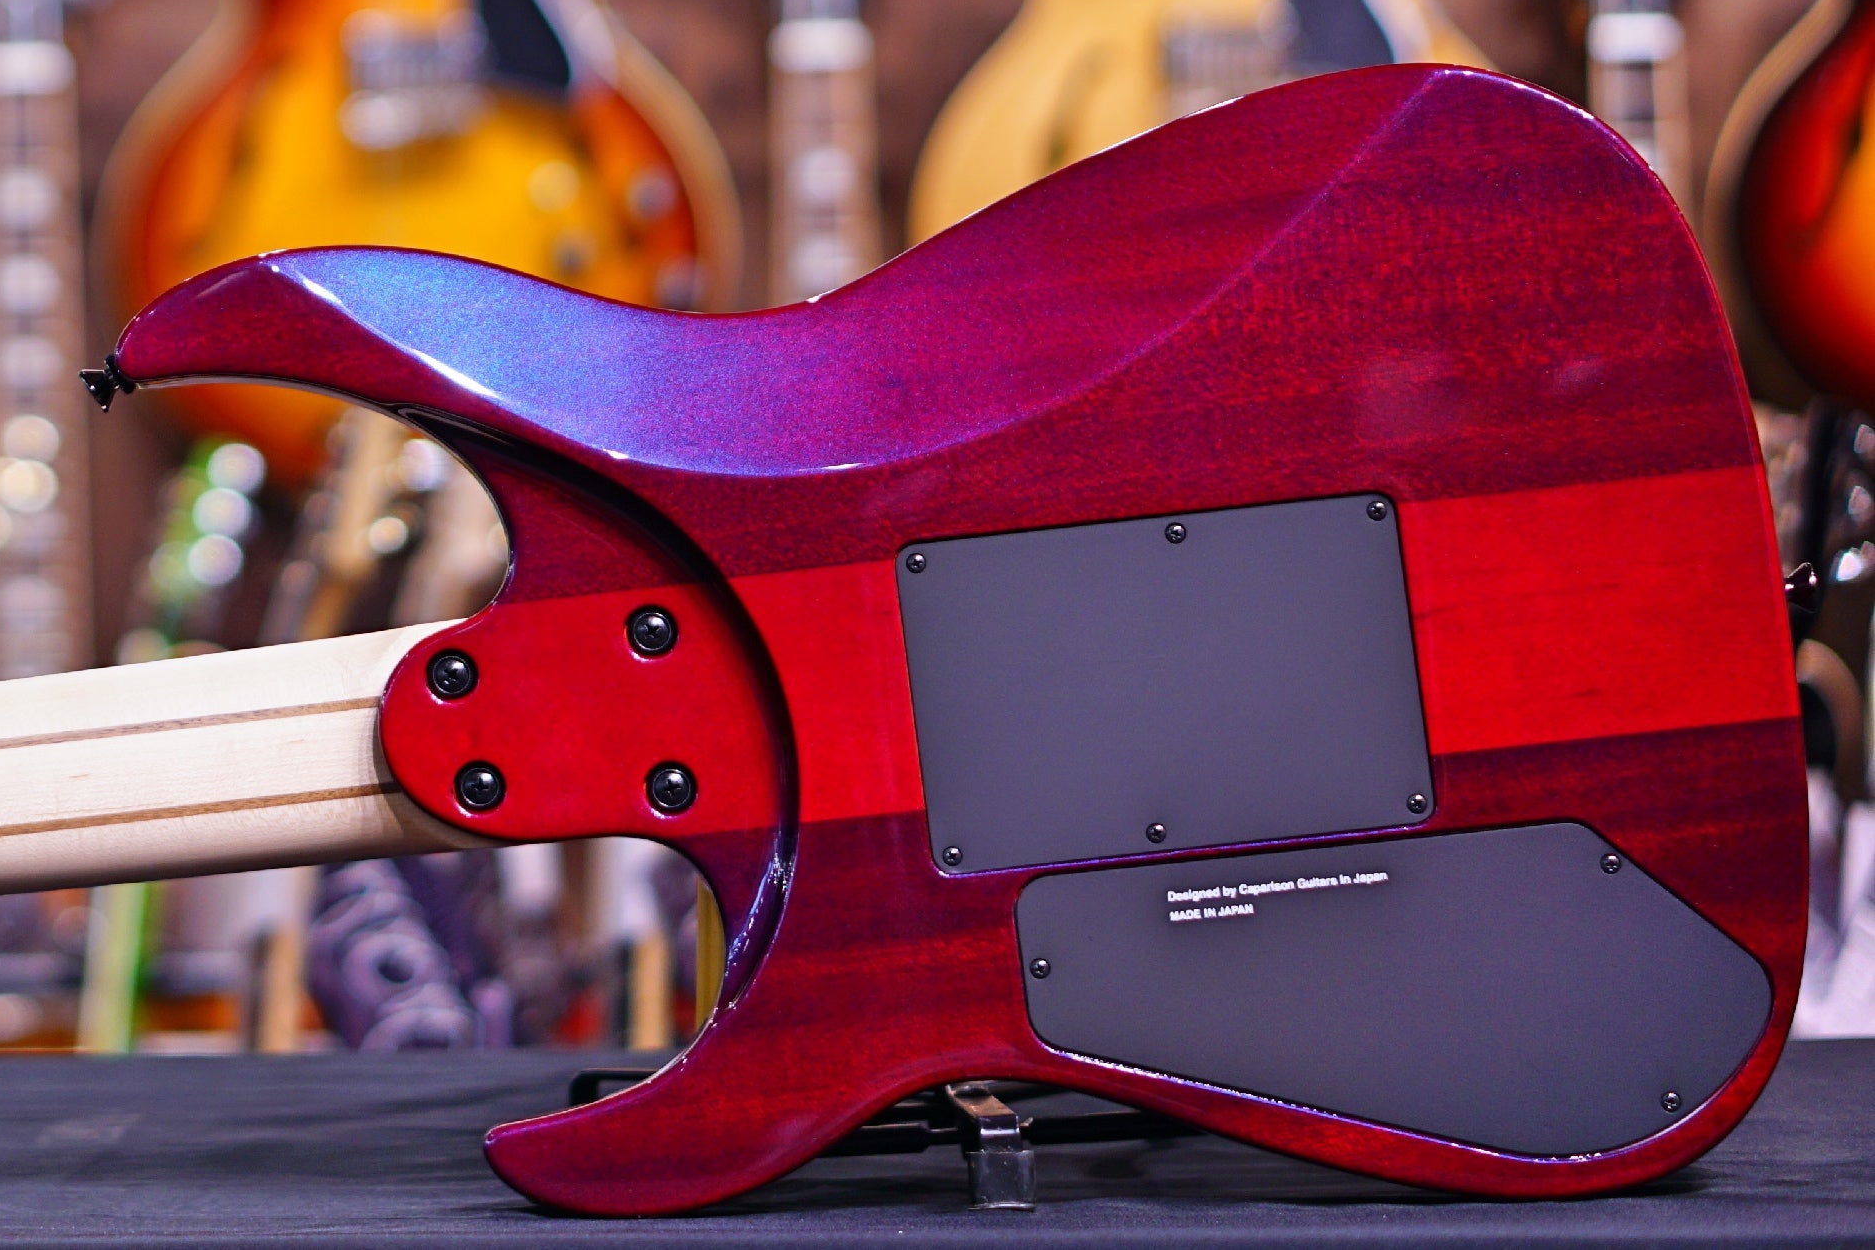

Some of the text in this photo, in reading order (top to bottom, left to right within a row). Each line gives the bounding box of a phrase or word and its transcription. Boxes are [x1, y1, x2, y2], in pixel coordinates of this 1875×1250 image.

[1167, 885, 1221, 901] Designed
[1222, 885, 1237, 898] by
[1238, 880, 1295, 896] Caparison
[1296, 876, 1338, 889] Guitars
[1353, 871, 1388, 885] Japan
[1169, 903, 1254, 922] MADE IN JAPAN
